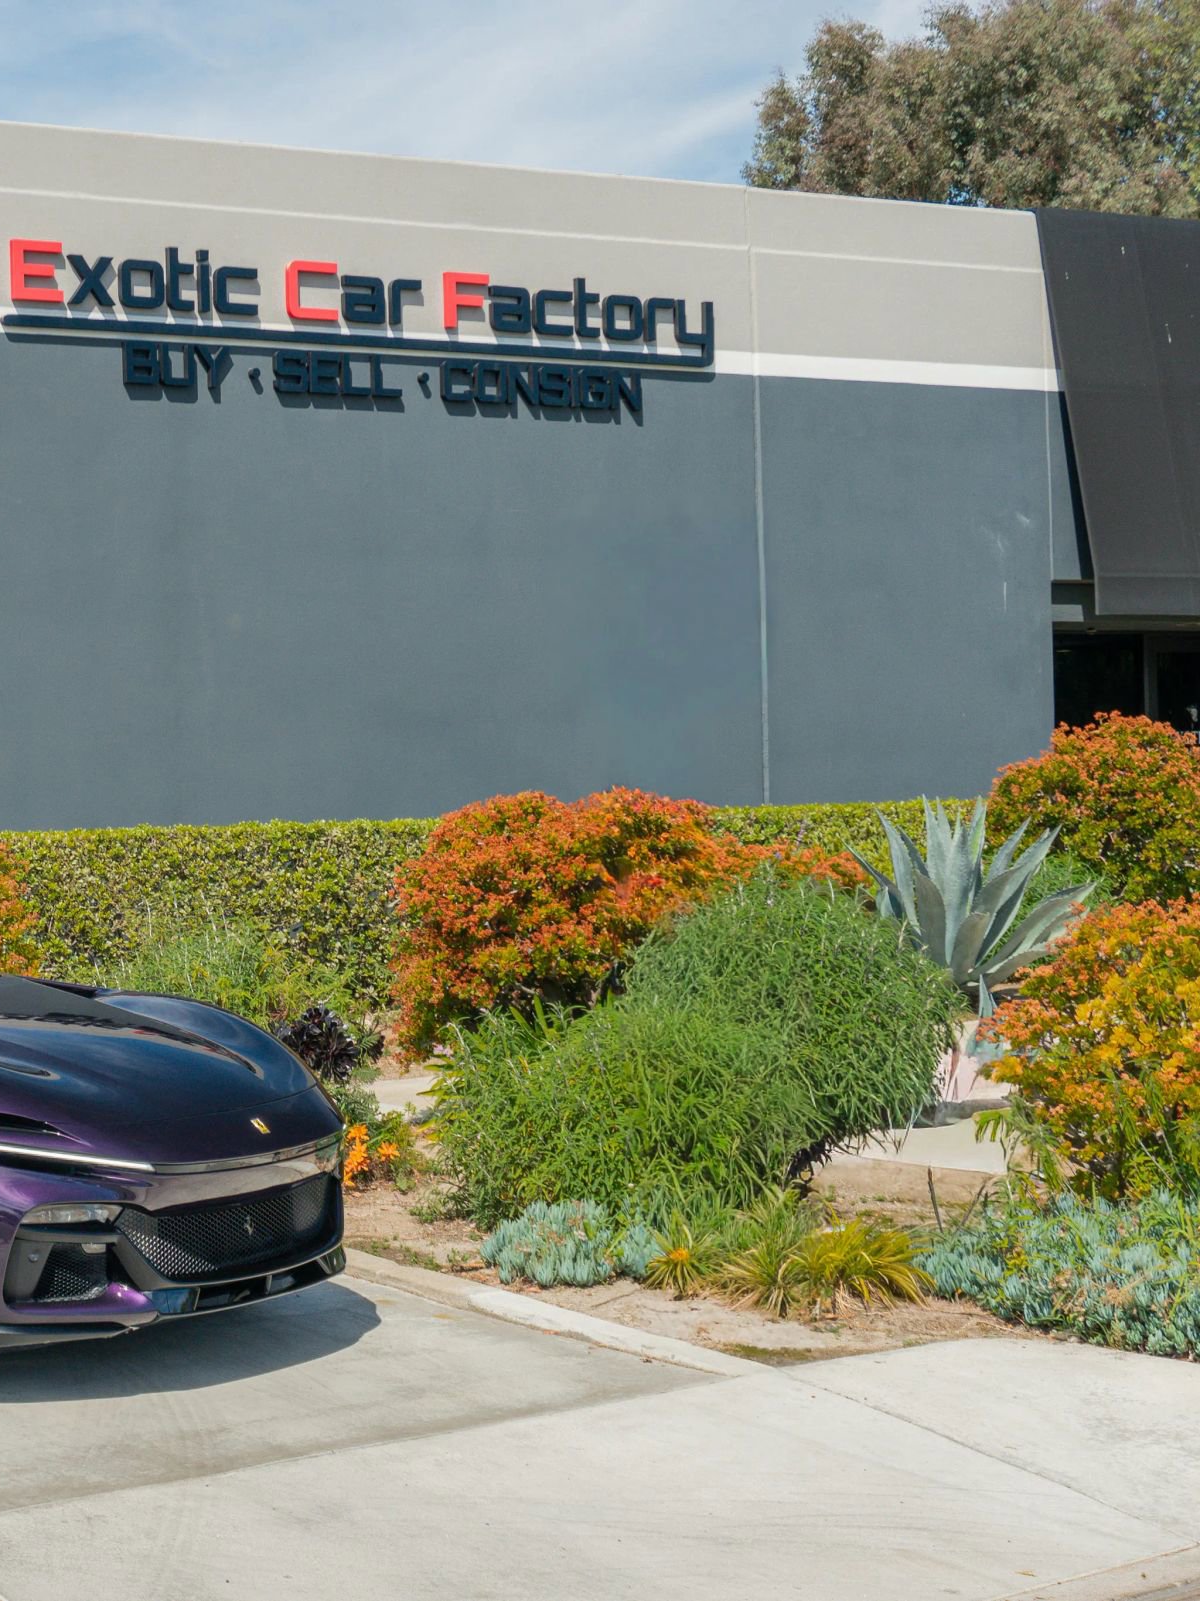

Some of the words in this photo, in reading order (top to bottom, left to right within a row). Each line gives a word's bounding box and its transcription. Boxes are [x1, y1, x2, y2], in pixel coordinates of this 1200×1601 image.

[10, 238, 258, 315] Exotic
[285, 260, 422, 326] Car
[442, 271, 714, 367] Factory
[122, 340, 228, 391] BUY
[272, 350, 403, 399] SELL
[439, 359, 642, 412] CONSIGN
